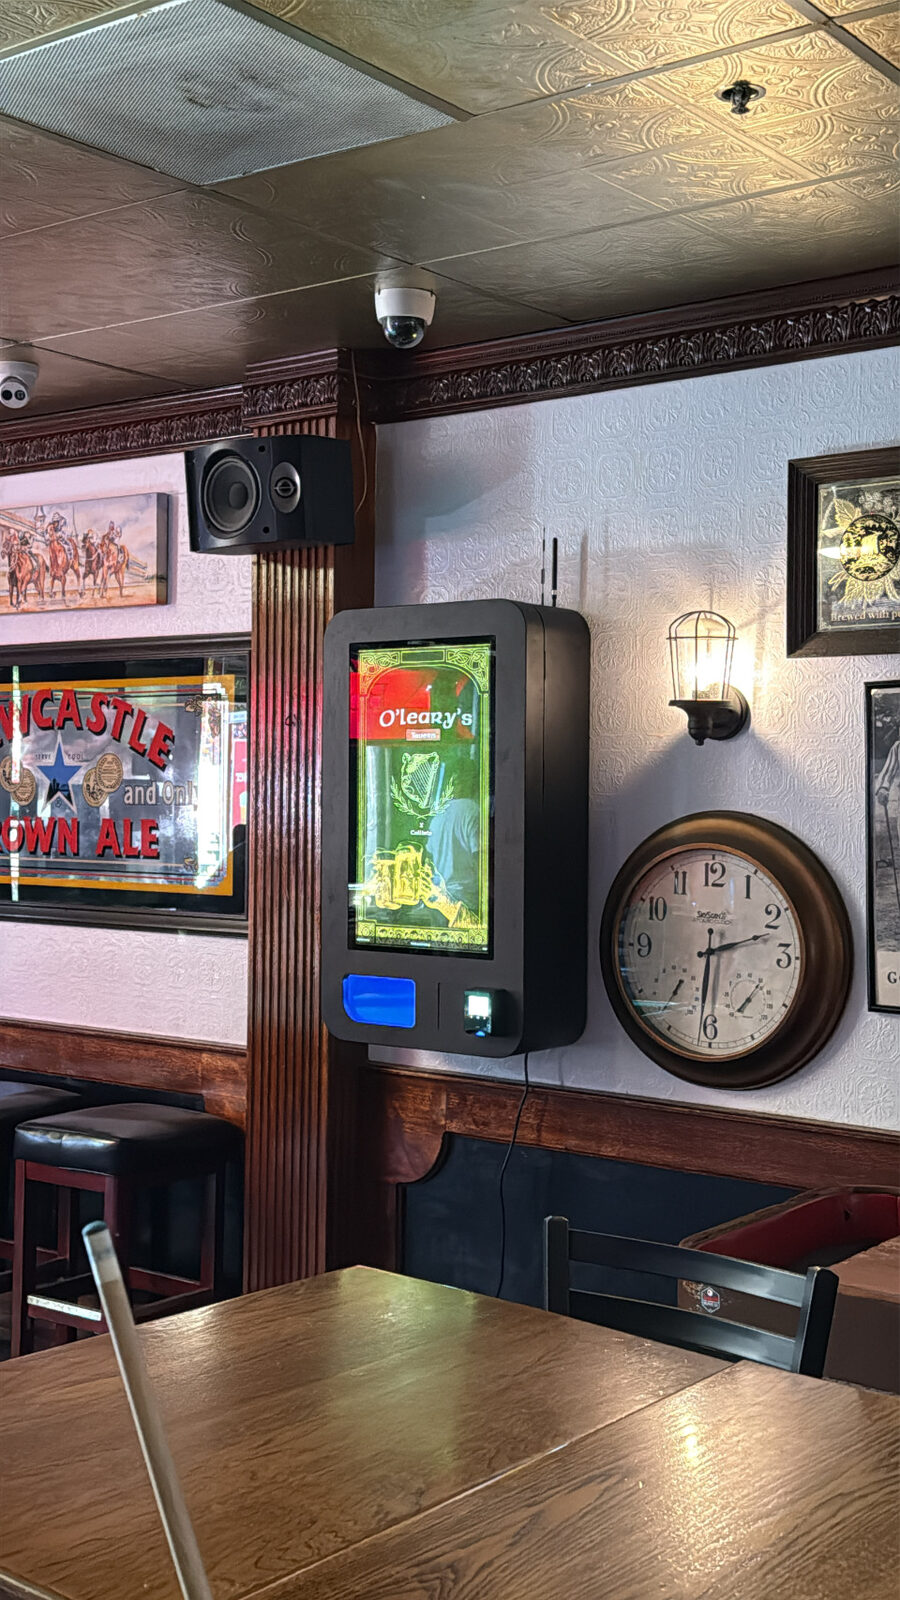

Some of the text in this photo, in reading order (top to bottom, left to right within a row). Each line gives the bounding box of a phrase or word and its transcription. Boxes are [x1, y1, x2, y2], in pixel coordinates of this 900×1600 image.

[0, 688, 175, 772] WCASTLE
[124, 781, 157, 805] and
[0, 815, 160, 859] OWN ALE
[673, 870, 687, 895] 11
[703, 862, 726, 888] 12
[745, 874, 751, 900] 1
[649, 896, 668, 921] 10
[764, 903, 782, 930] 2
[637, 932, 652, 958] 9
[776, 943, 792, 969] 3
[887, 971, 900, 985] G
[703, 1014, 718, 1040] 6
